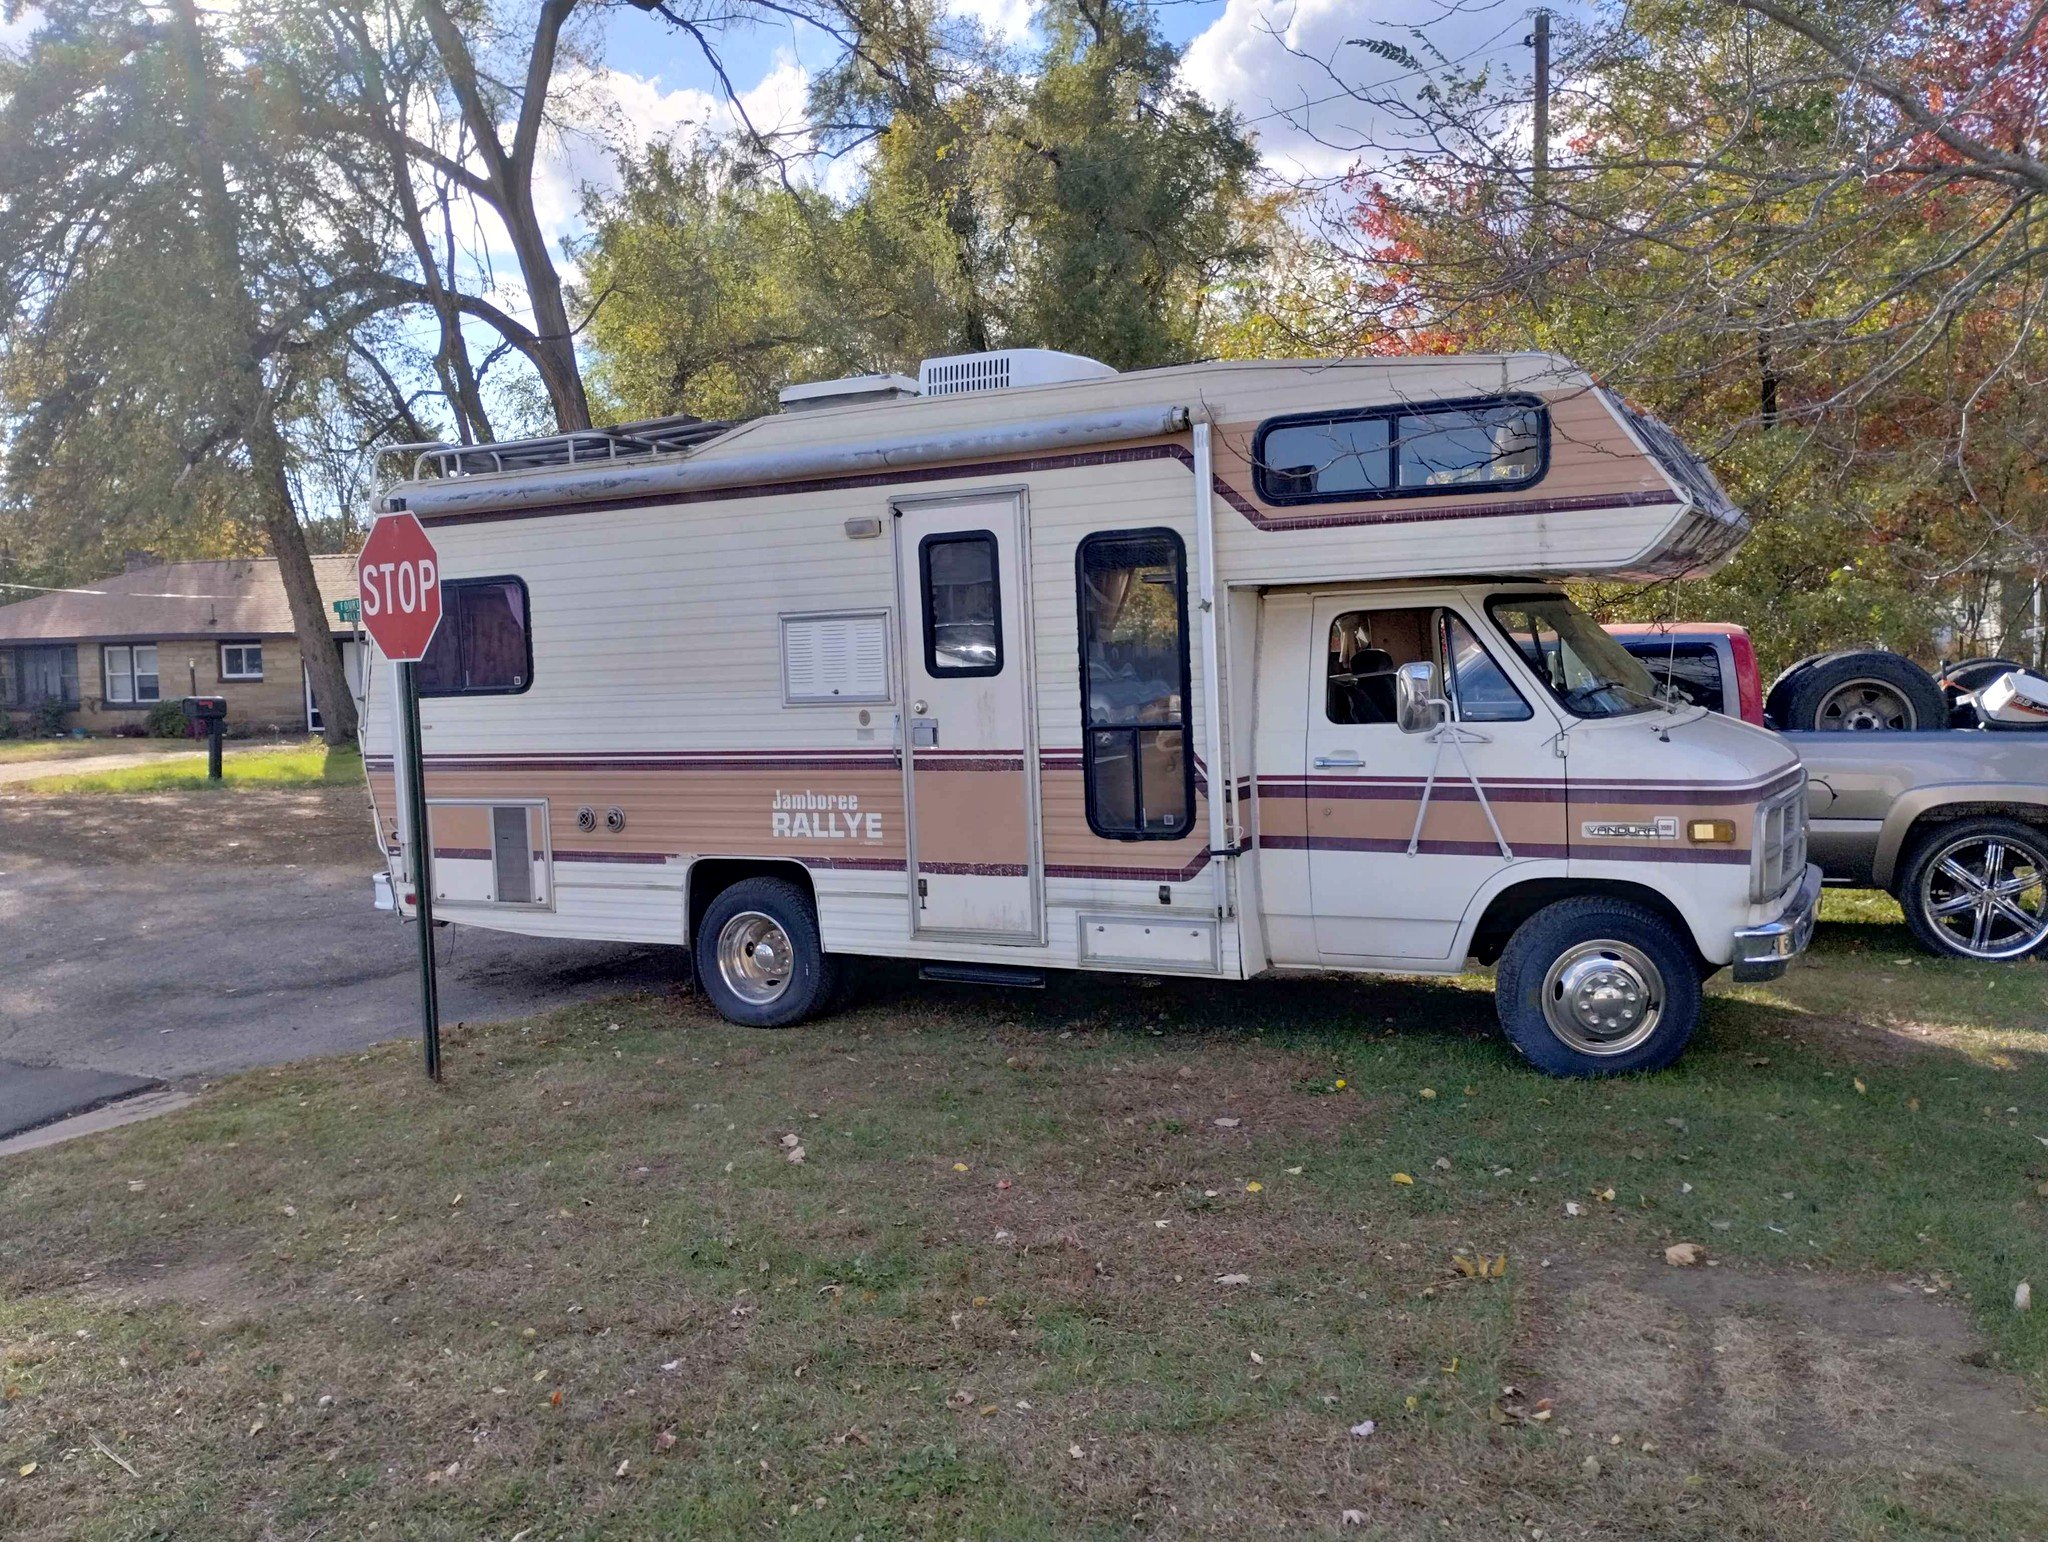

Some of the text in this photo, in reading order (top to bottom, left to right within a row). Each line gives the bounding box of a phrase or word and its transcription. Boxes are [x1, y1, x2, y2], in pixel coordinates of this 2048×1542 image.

[362, 559, 436, 616] STOP
[340, 600, 360, 610] FOURT
[772, 789, 858, 810] Jamboree
[772, 812, 883, 838] RALLYE
[1585, 825, 1658, 836] VANDURA
